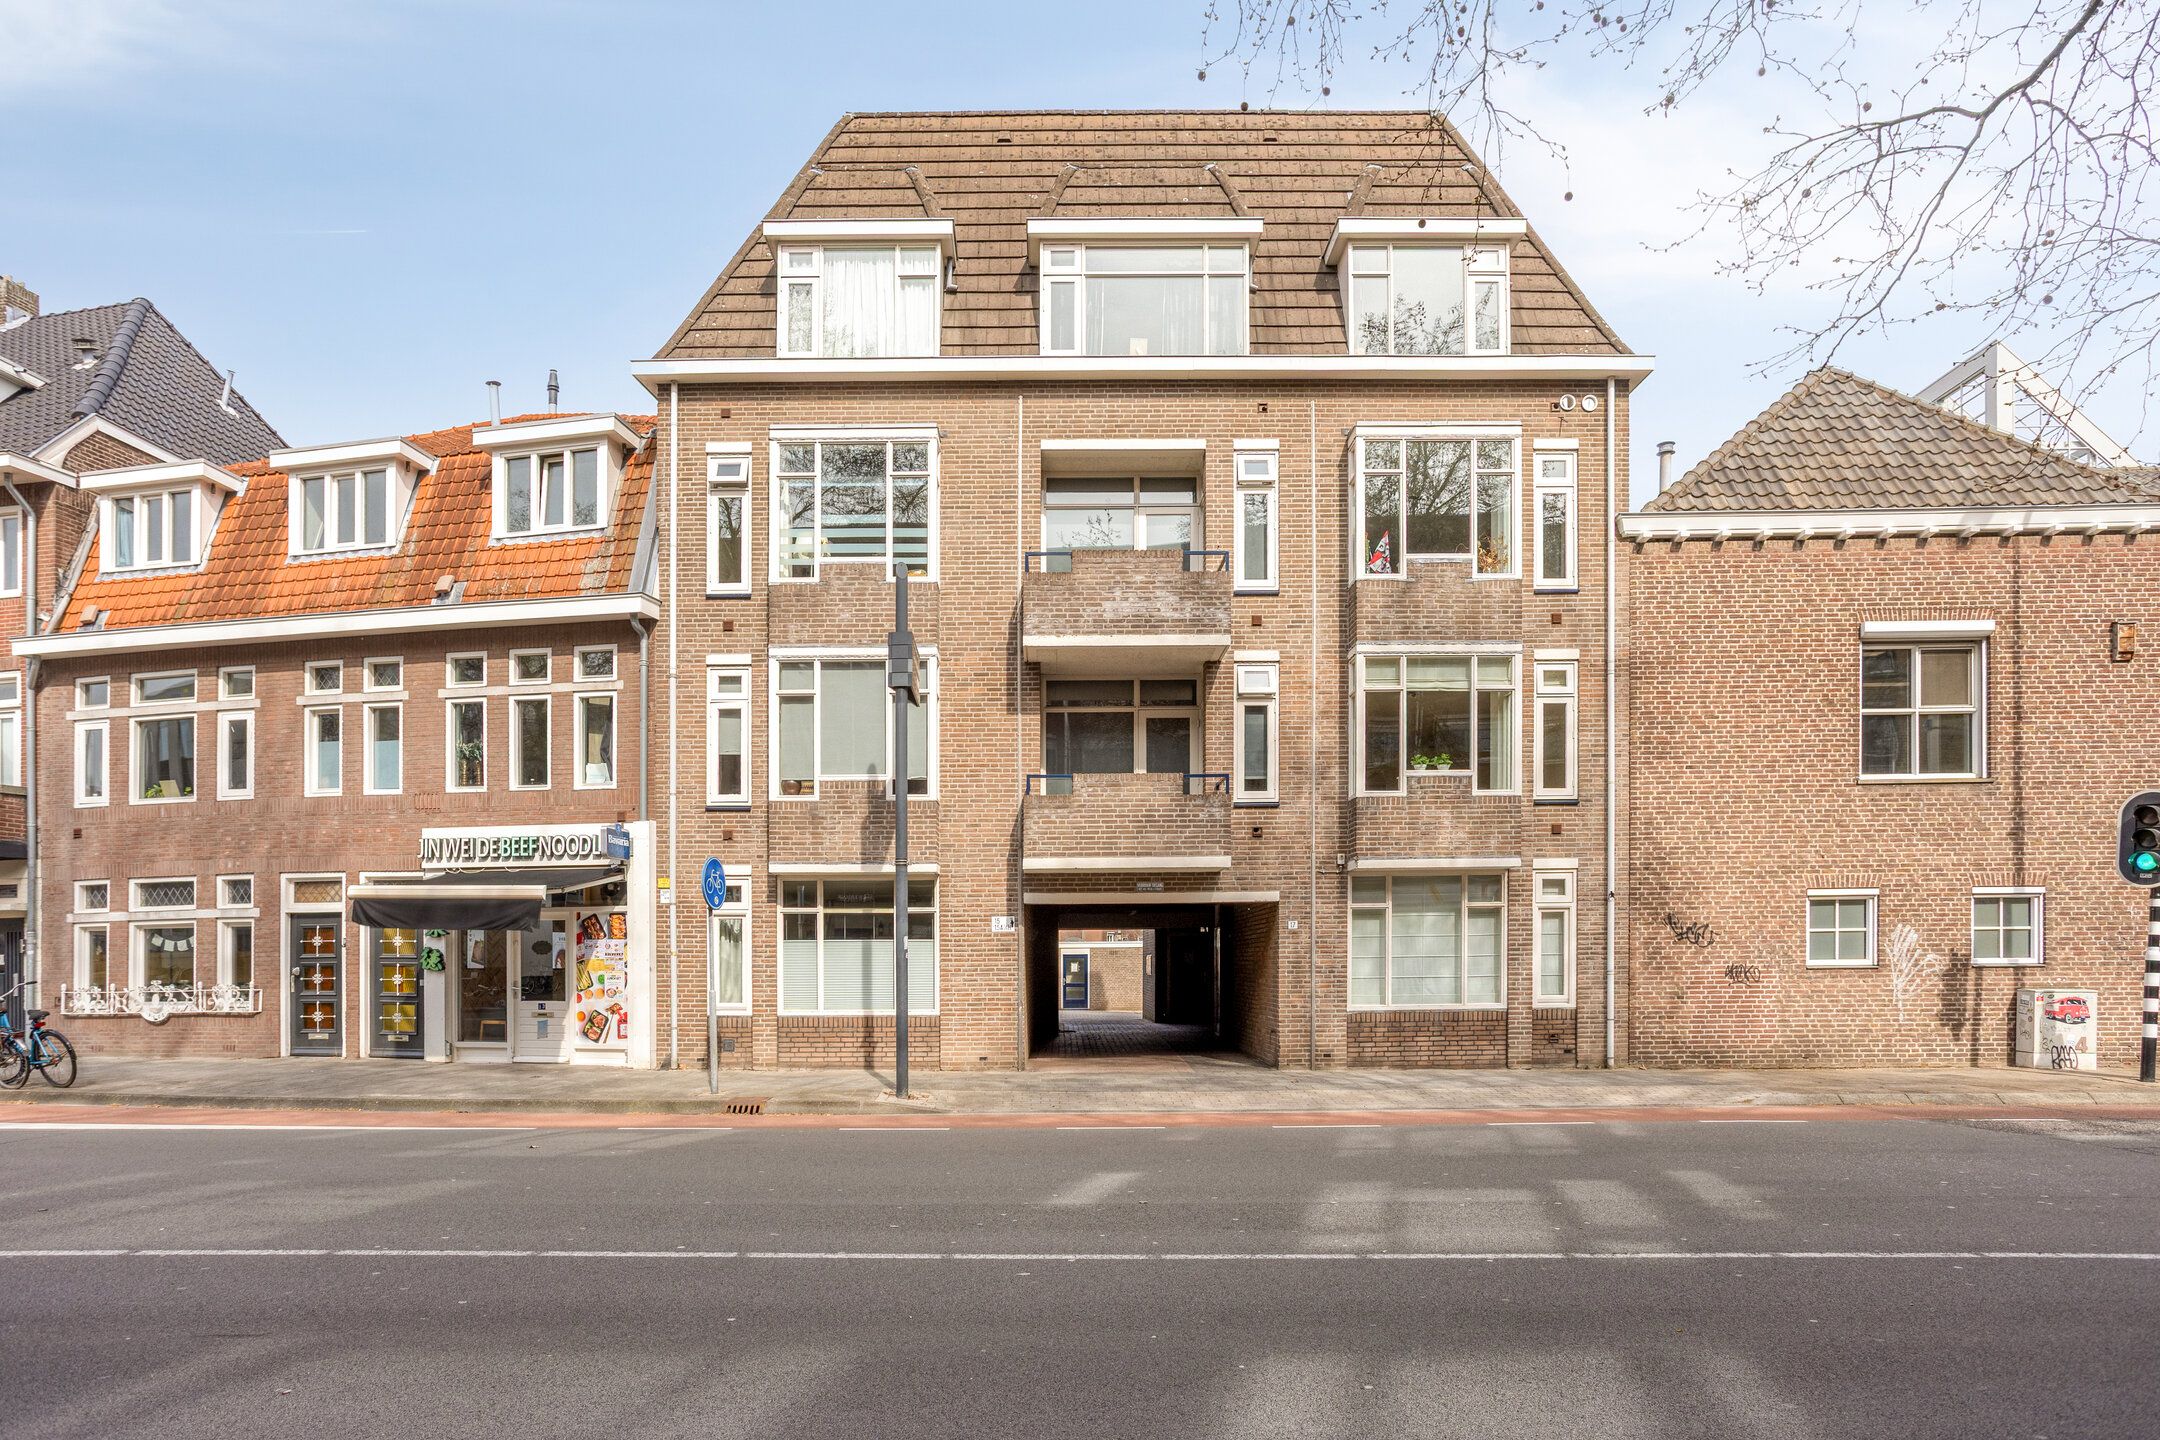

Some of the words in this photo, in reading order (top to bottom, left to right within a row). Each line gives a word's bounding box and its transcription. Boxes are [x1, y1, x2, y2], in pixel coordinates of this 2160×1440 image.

[418, 838, 441, 858] JIN
[442, 837, 474, 857] WEI
[477, 837, 501, 857] DE
[500, 836, 540, 857] BEEF
[538, 834, 601, 856] NOODL
